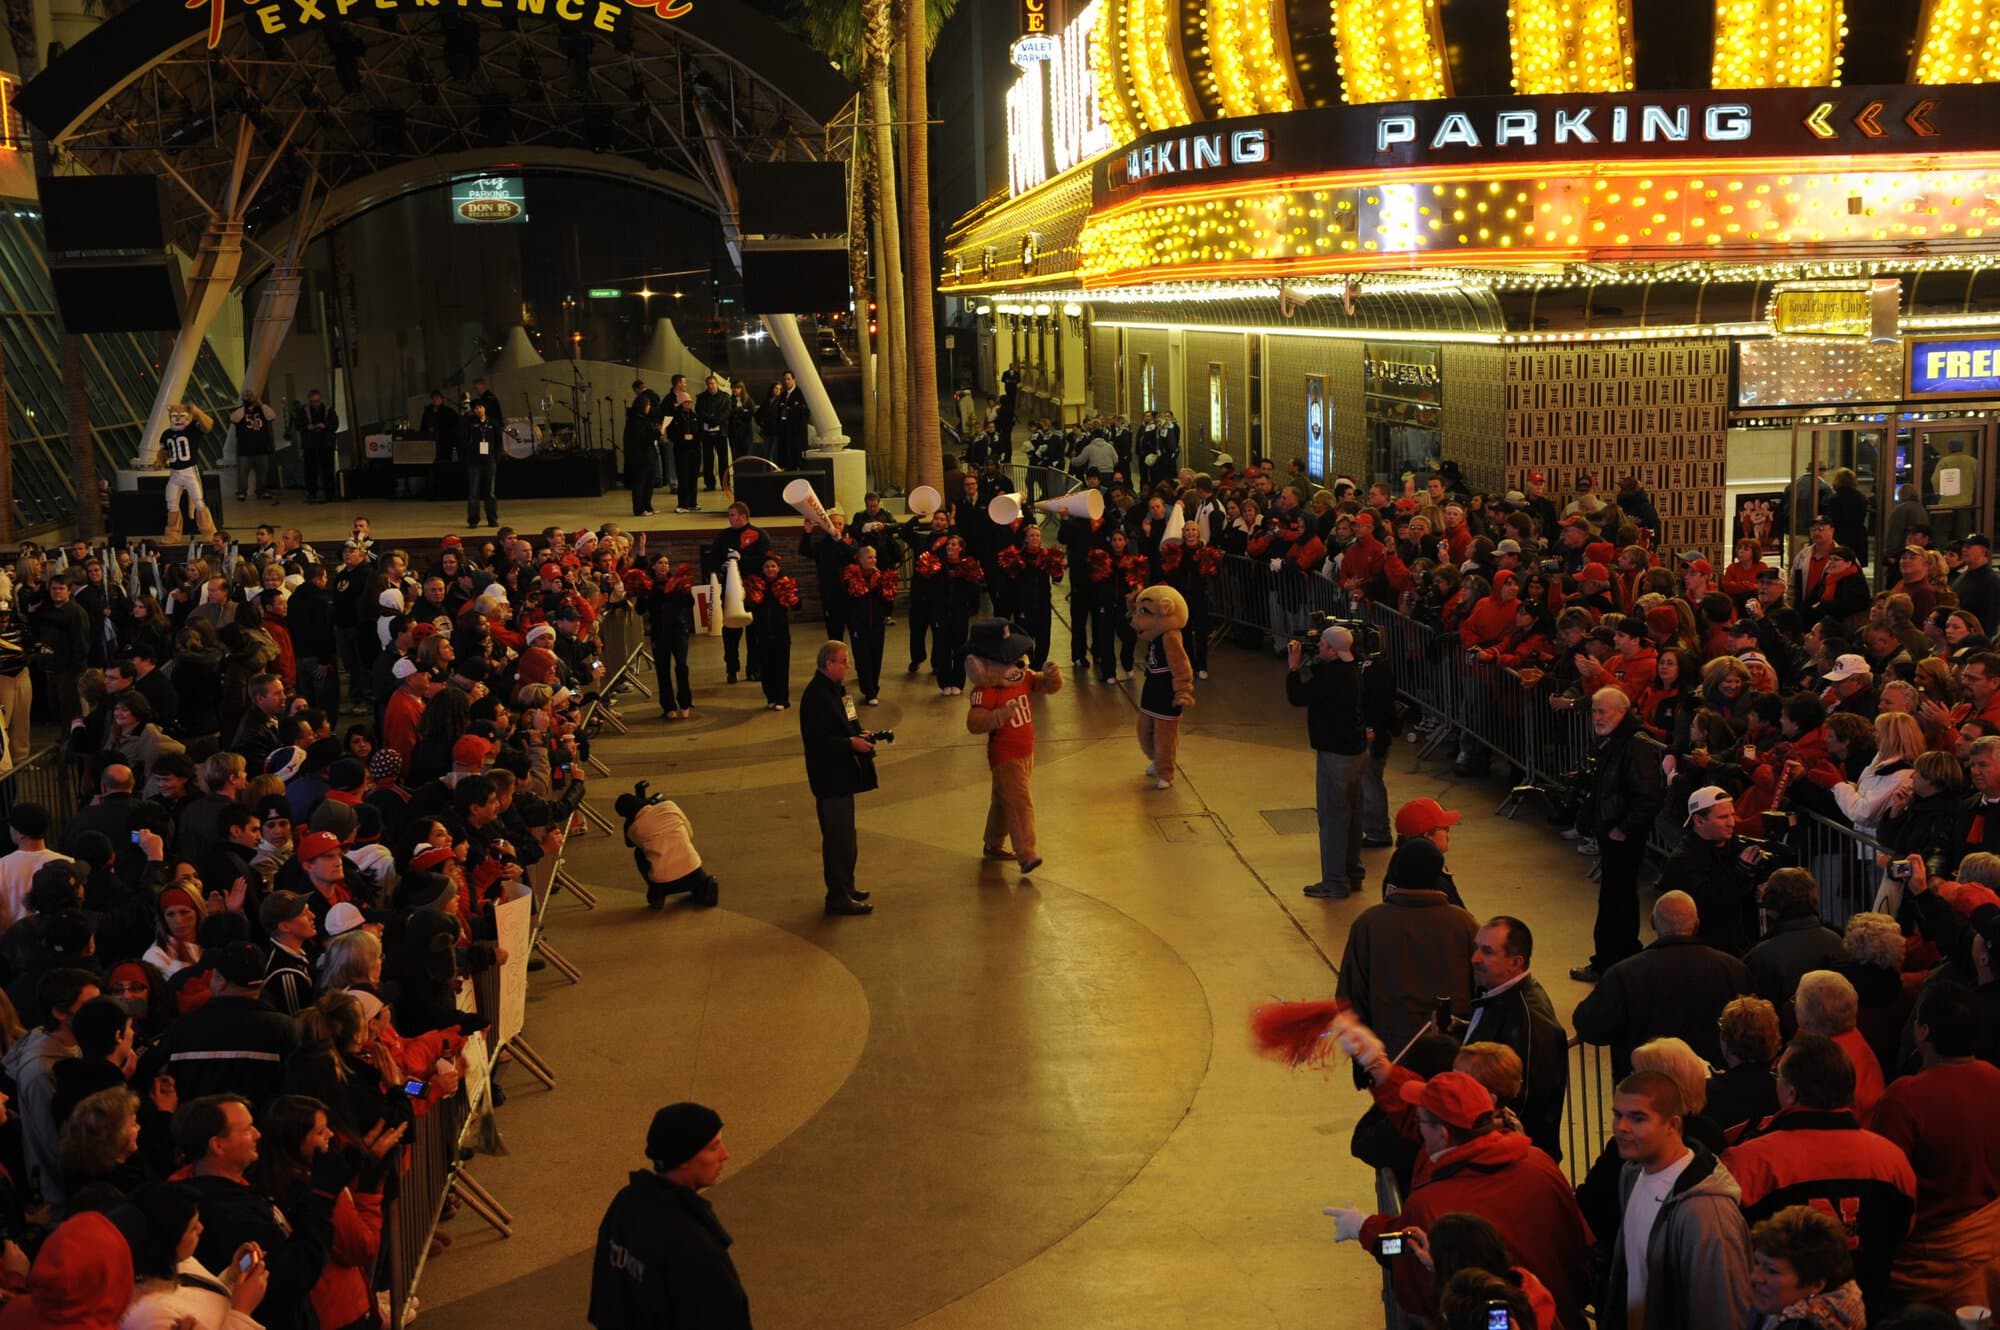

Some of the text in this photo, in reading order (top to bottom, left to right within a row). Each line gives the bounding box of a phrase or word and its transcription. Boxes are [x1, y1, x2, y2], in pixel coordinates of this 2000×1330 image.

[260, 0, 622, 34] EXPNCE
[1021, 42, 1052, 52] VALET
[1017, 53, 1051, 62] PARKIN
[1377, 104, 1753, 153] PARKING
[468, 190, 509, 199] PARKING
[468, 204, 493, 212] DON
[1789, 298, 1862, 314] Royal Players Club
[1378, 360, 1436, 387] QUEENS
